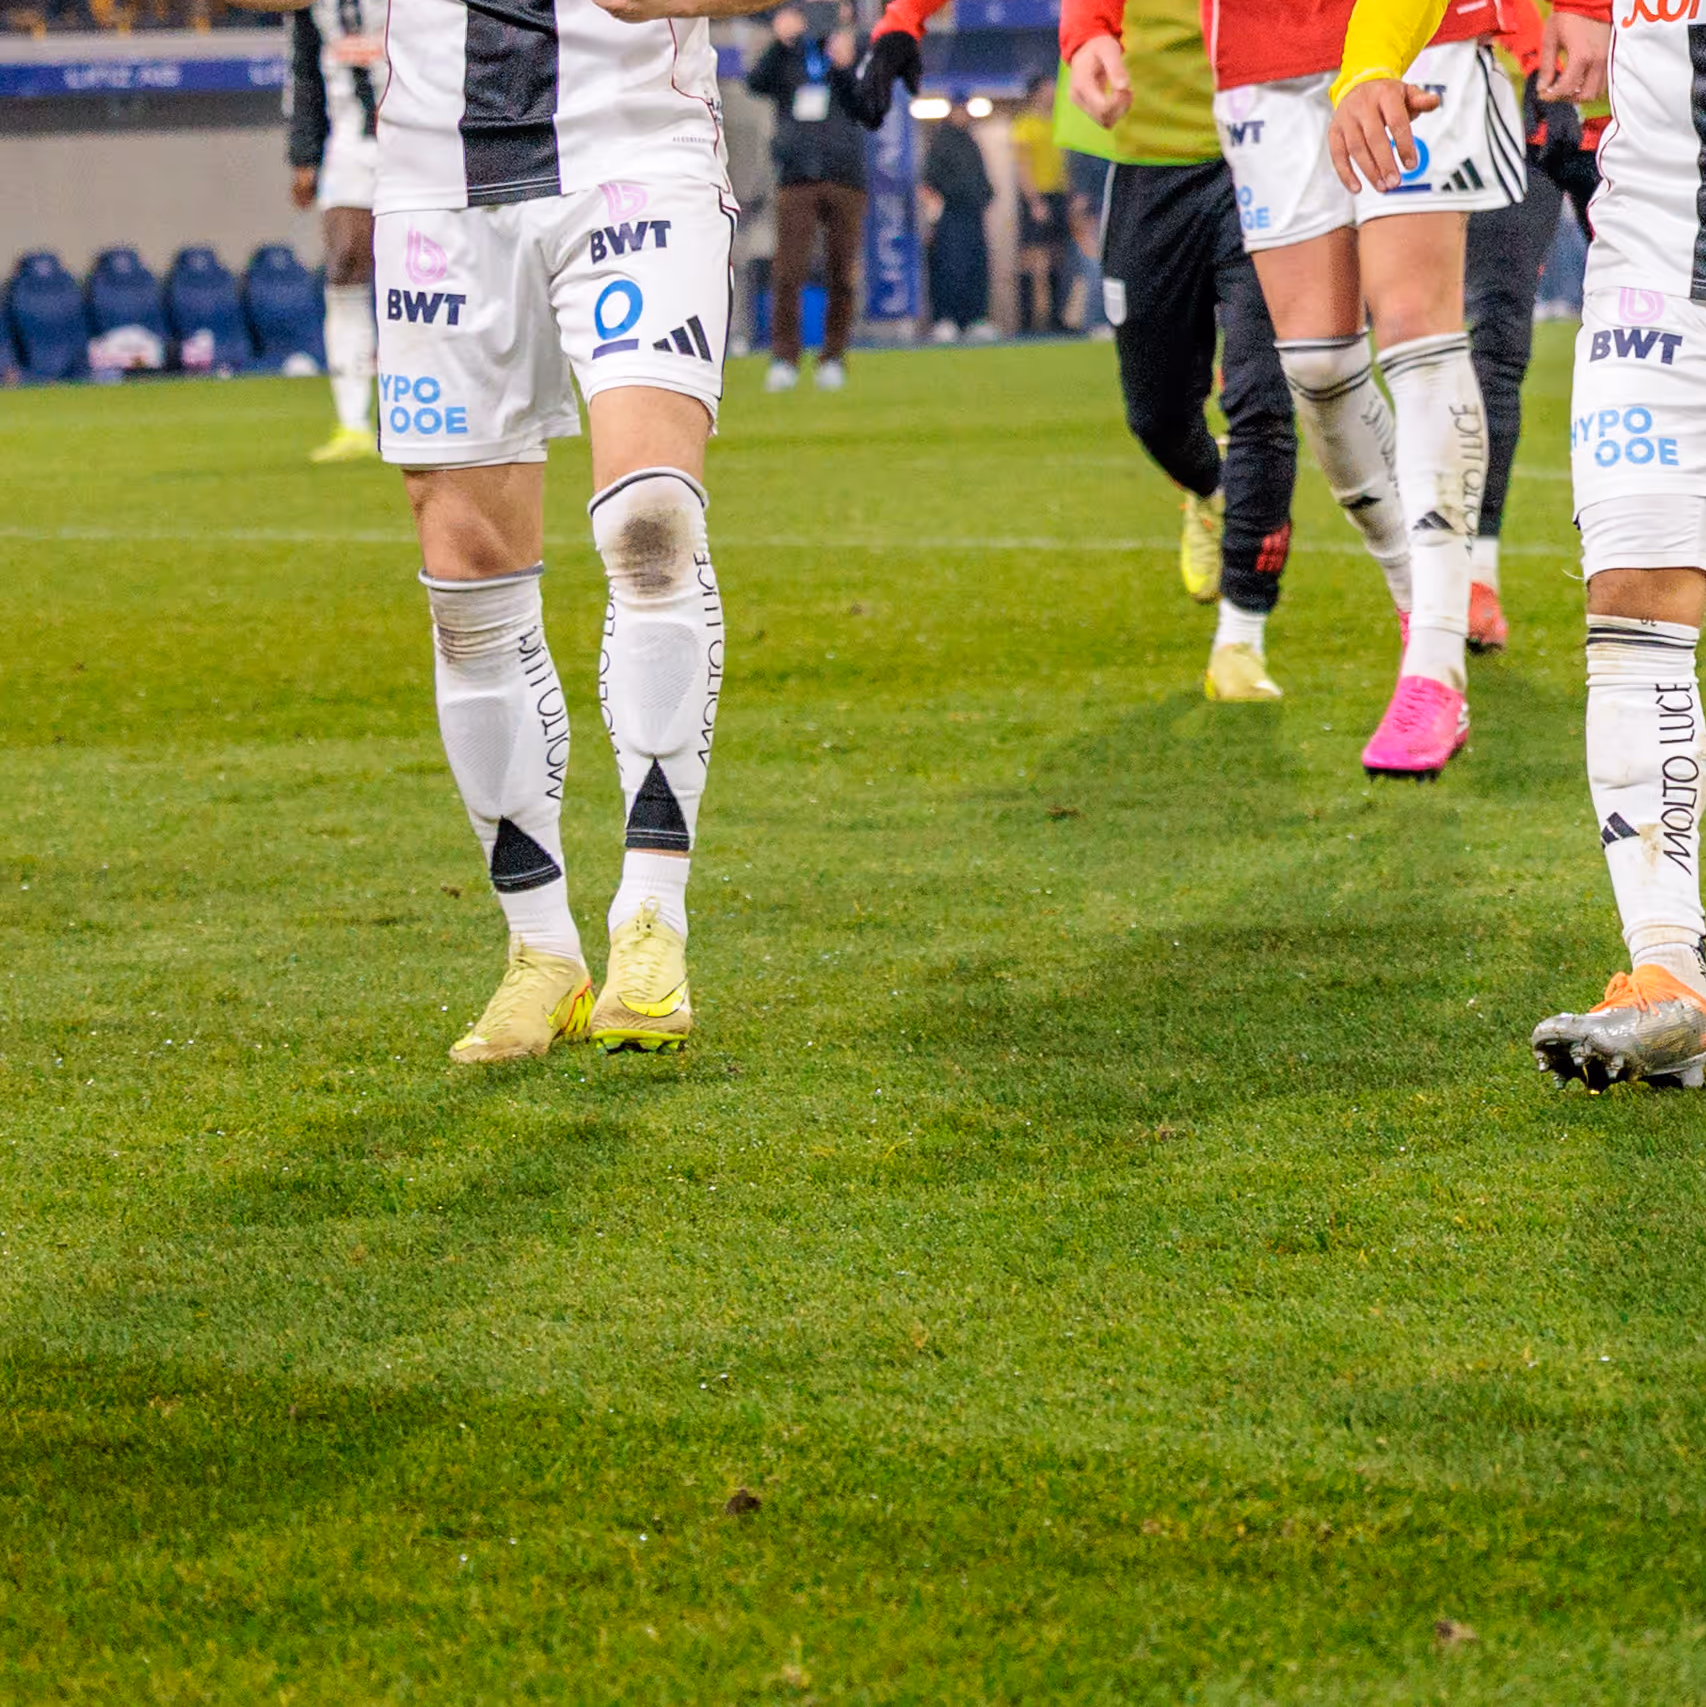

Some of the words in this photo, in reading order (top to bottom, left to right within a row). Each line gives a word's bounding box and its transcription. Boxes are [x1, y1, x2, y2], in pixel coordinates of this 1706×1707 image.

[590, 220, 672, 264] BWT
[387, 288, 466, 326] BWT
[1589, 328, 1683, 365] BWT
[379, 374, 441, 403] YPO
[389, 406, 468, 434] OOE
[1595, 437, 1680, 467] OOE
[1655, 681, 1695, 745] LUCE
[1661, 755, 1700, 876] MOLTO
